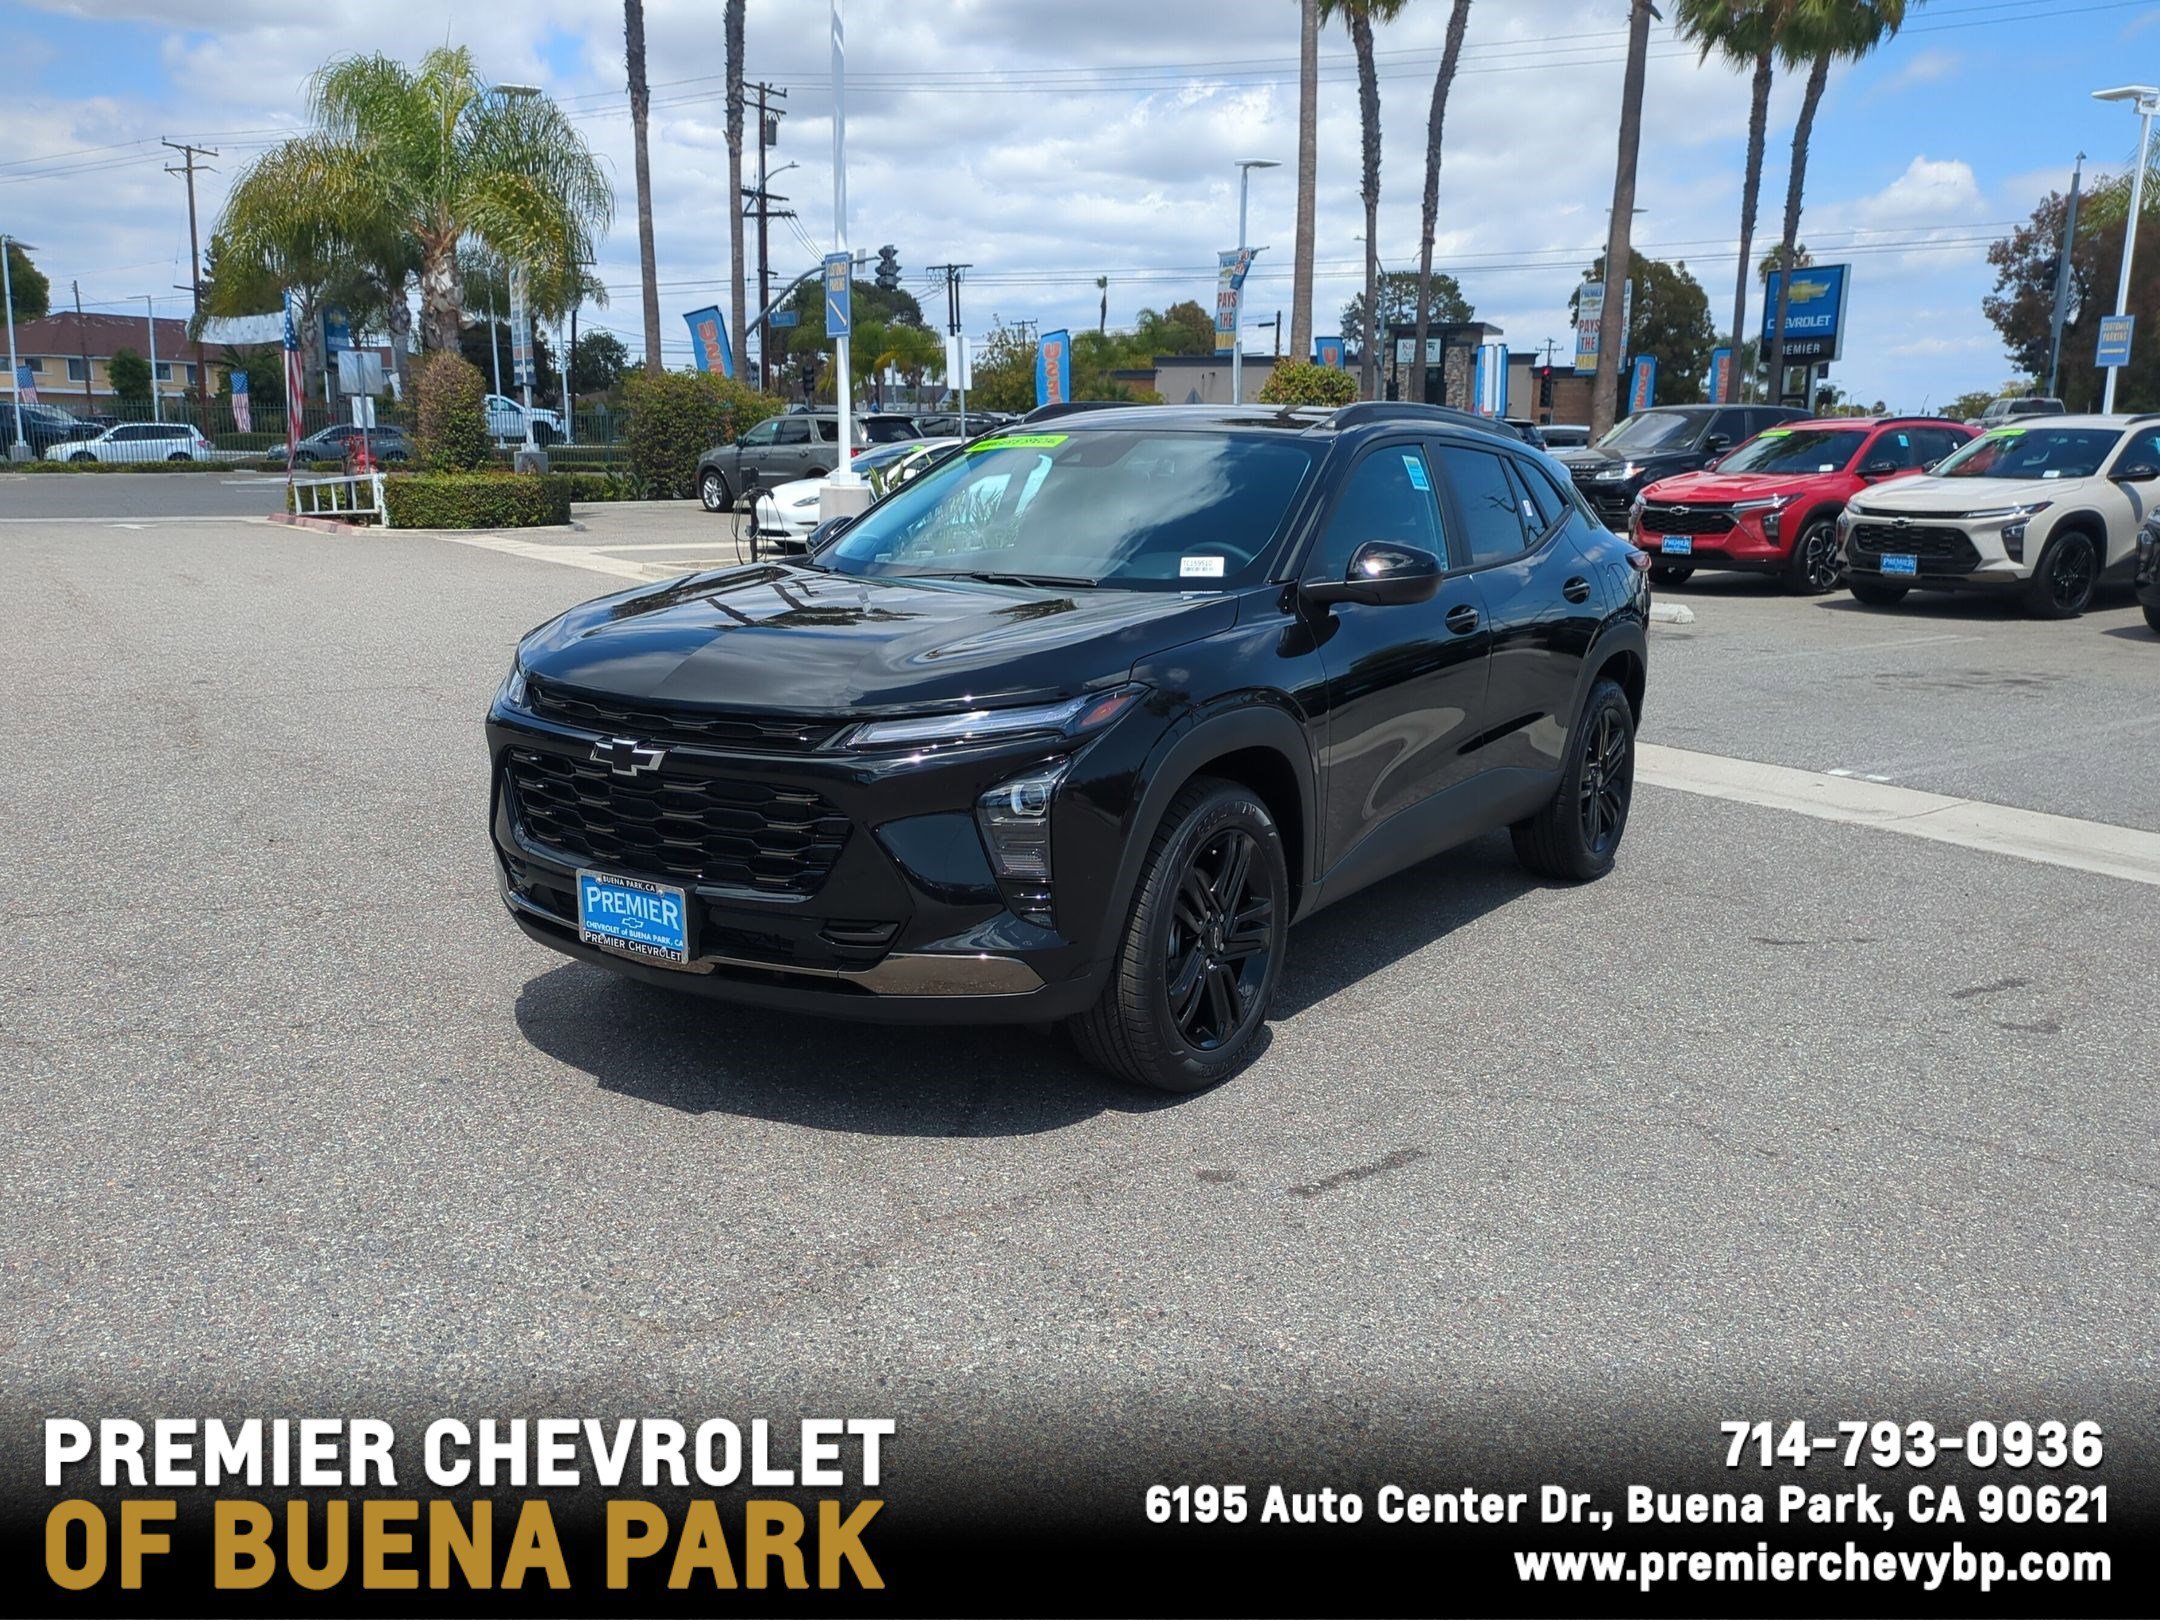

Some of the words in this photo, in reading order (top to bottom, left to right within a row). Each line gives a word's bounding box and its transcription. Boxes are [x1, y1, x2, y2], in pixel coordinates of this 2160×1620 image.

[1217, 291, 1237, 308] PAYS
[1219, 312, 1233, 328] THE
[1578, 319, 1600, 334] PAYS
[1767, 314, 1832, 330] CEVROLET
[1580, 336, 1595, 350] THE
[602, 875, 624, 887] BUENA
[586, 886, 681, 931] PREMIER
[586, 920, 620, 934] CHEVROLET
[629, 929, 652, 941] BUENA
[674, 938, 683, 947] CA
[585, 931, 626, 949] PREMIER
[628, 940, 681, 961] CHEVROLET
